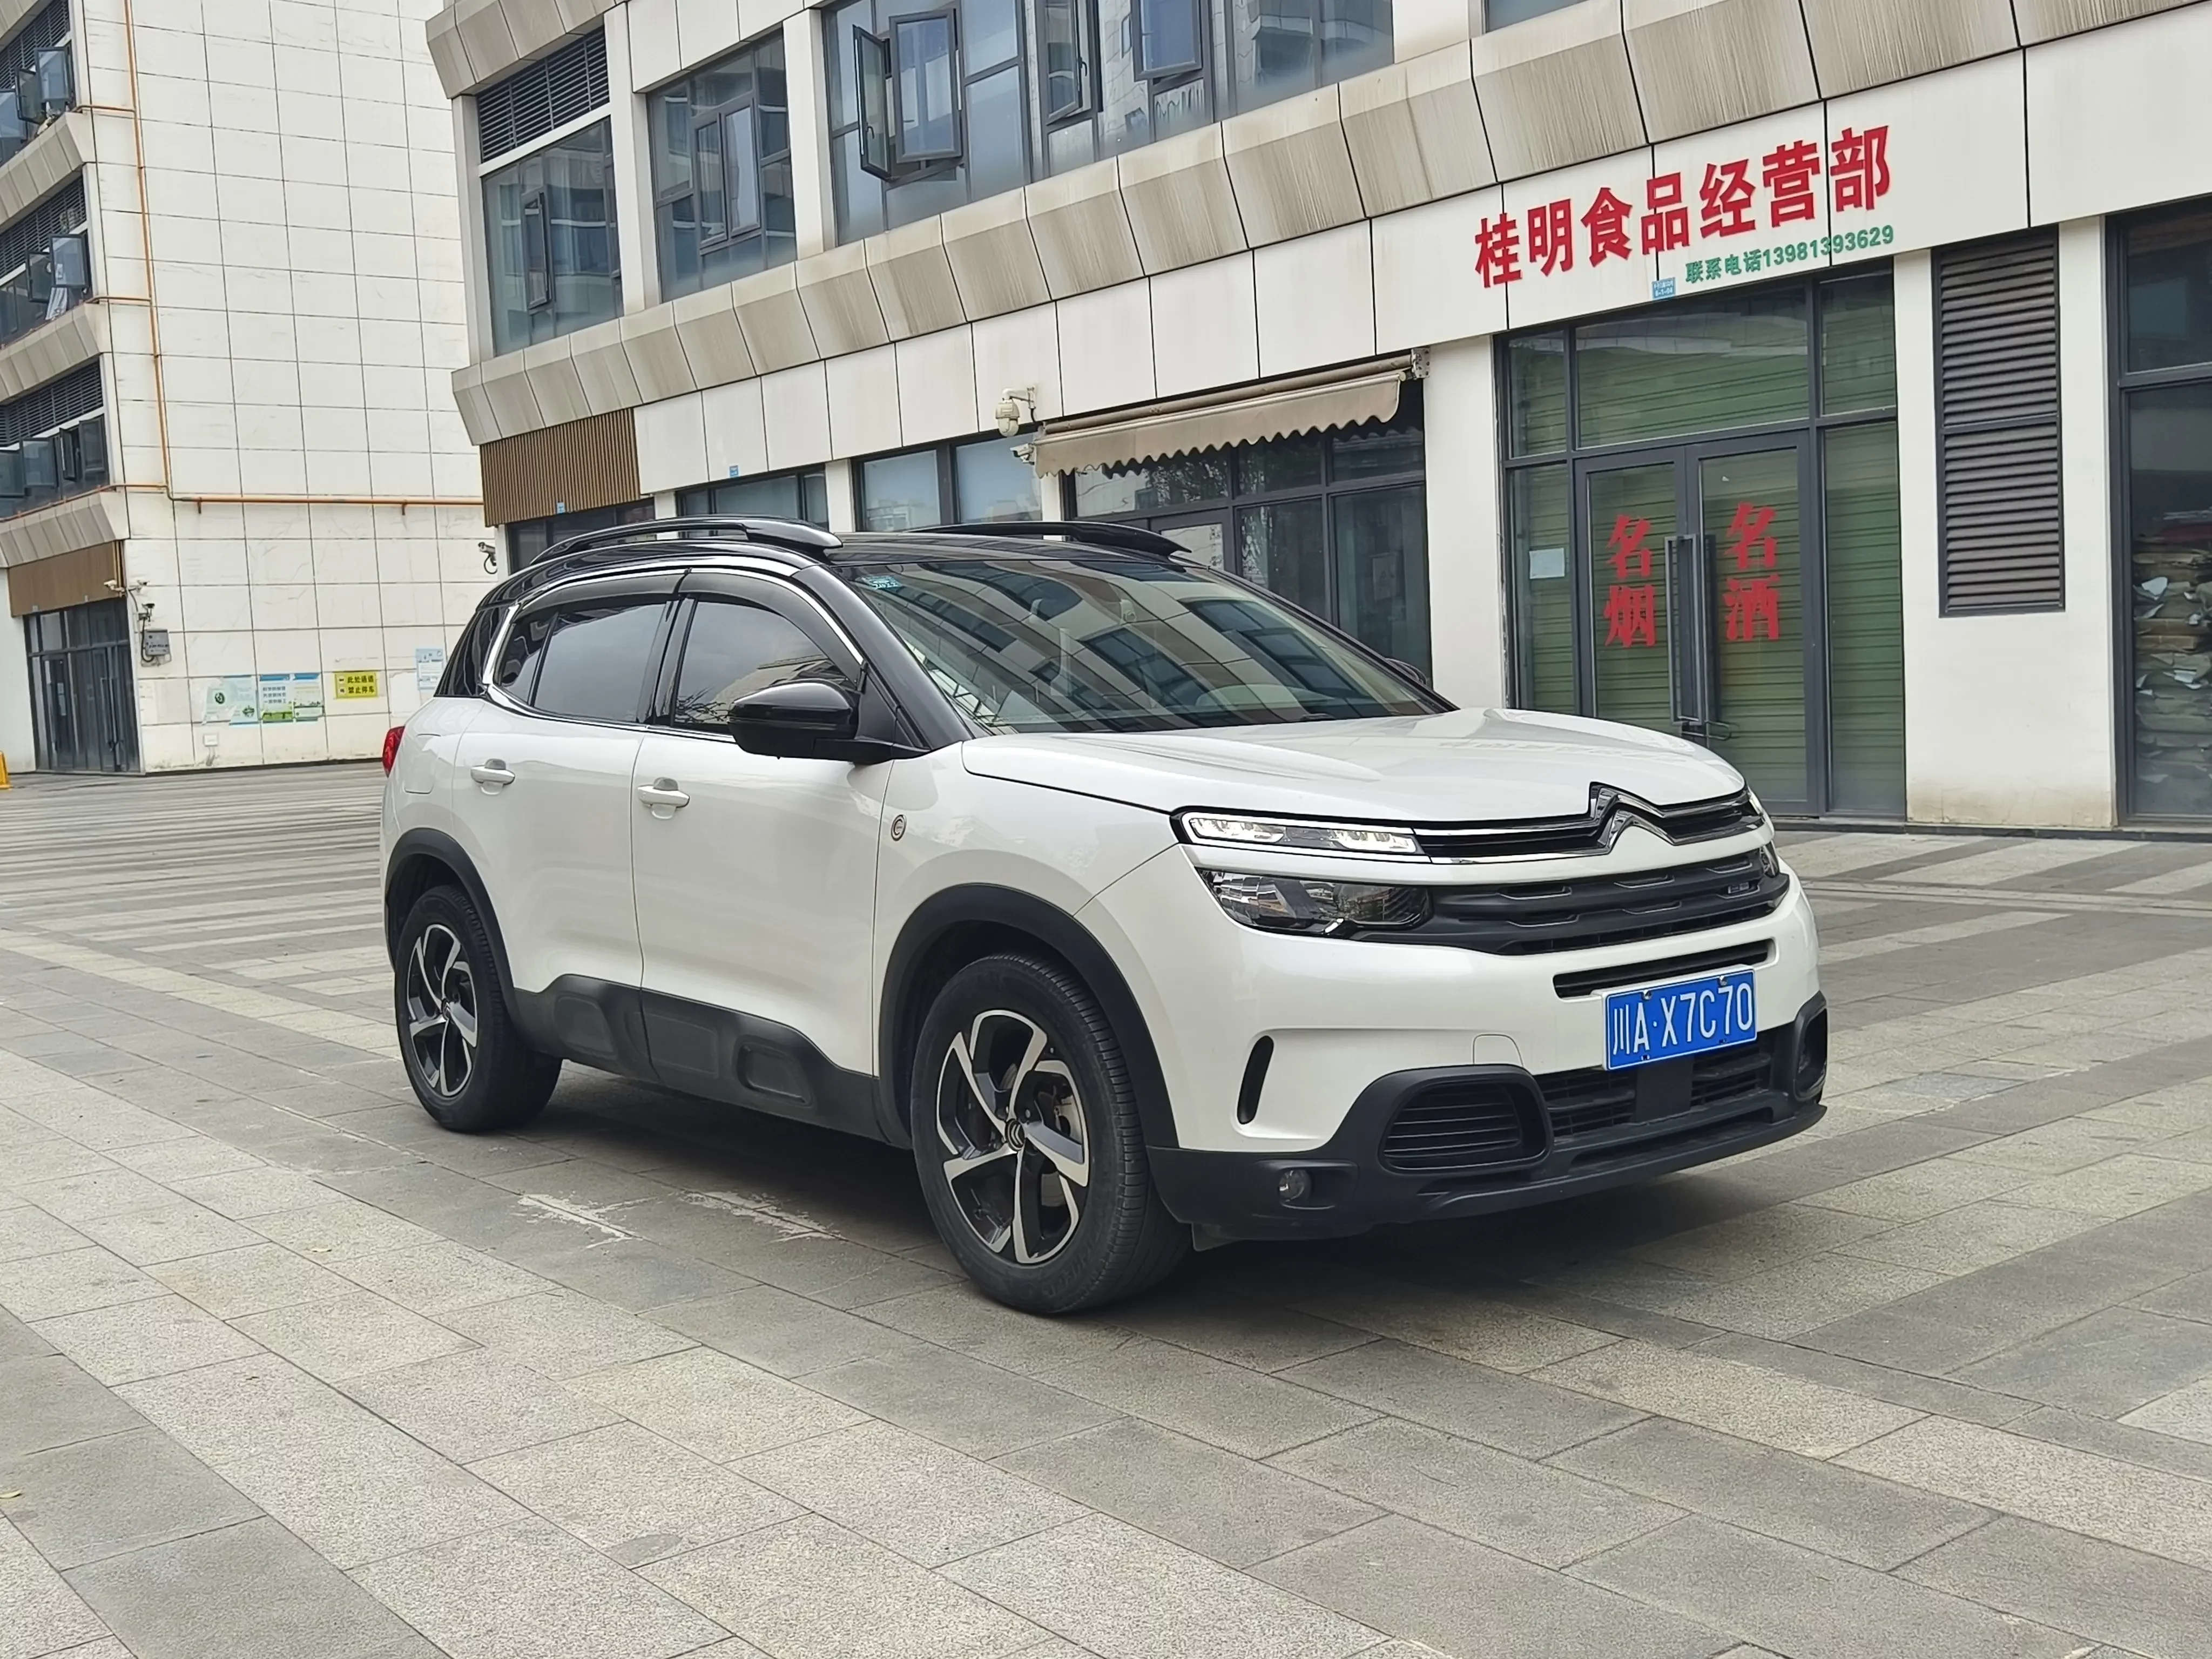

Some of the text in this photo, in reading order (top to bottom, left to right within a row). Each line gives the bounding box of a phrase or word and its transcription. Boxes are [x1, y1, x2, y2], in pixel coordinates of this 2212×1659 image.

[1475, 125, 1891, 288] 桂明食品经营部
[1685, 225, 1893, 283] 联系电话13981393629
[1603, 515, 1657, 648] 名烟
[1724, 502, 1781, 642] 名酒
[348, 686, 374, 694] 禁止停车
